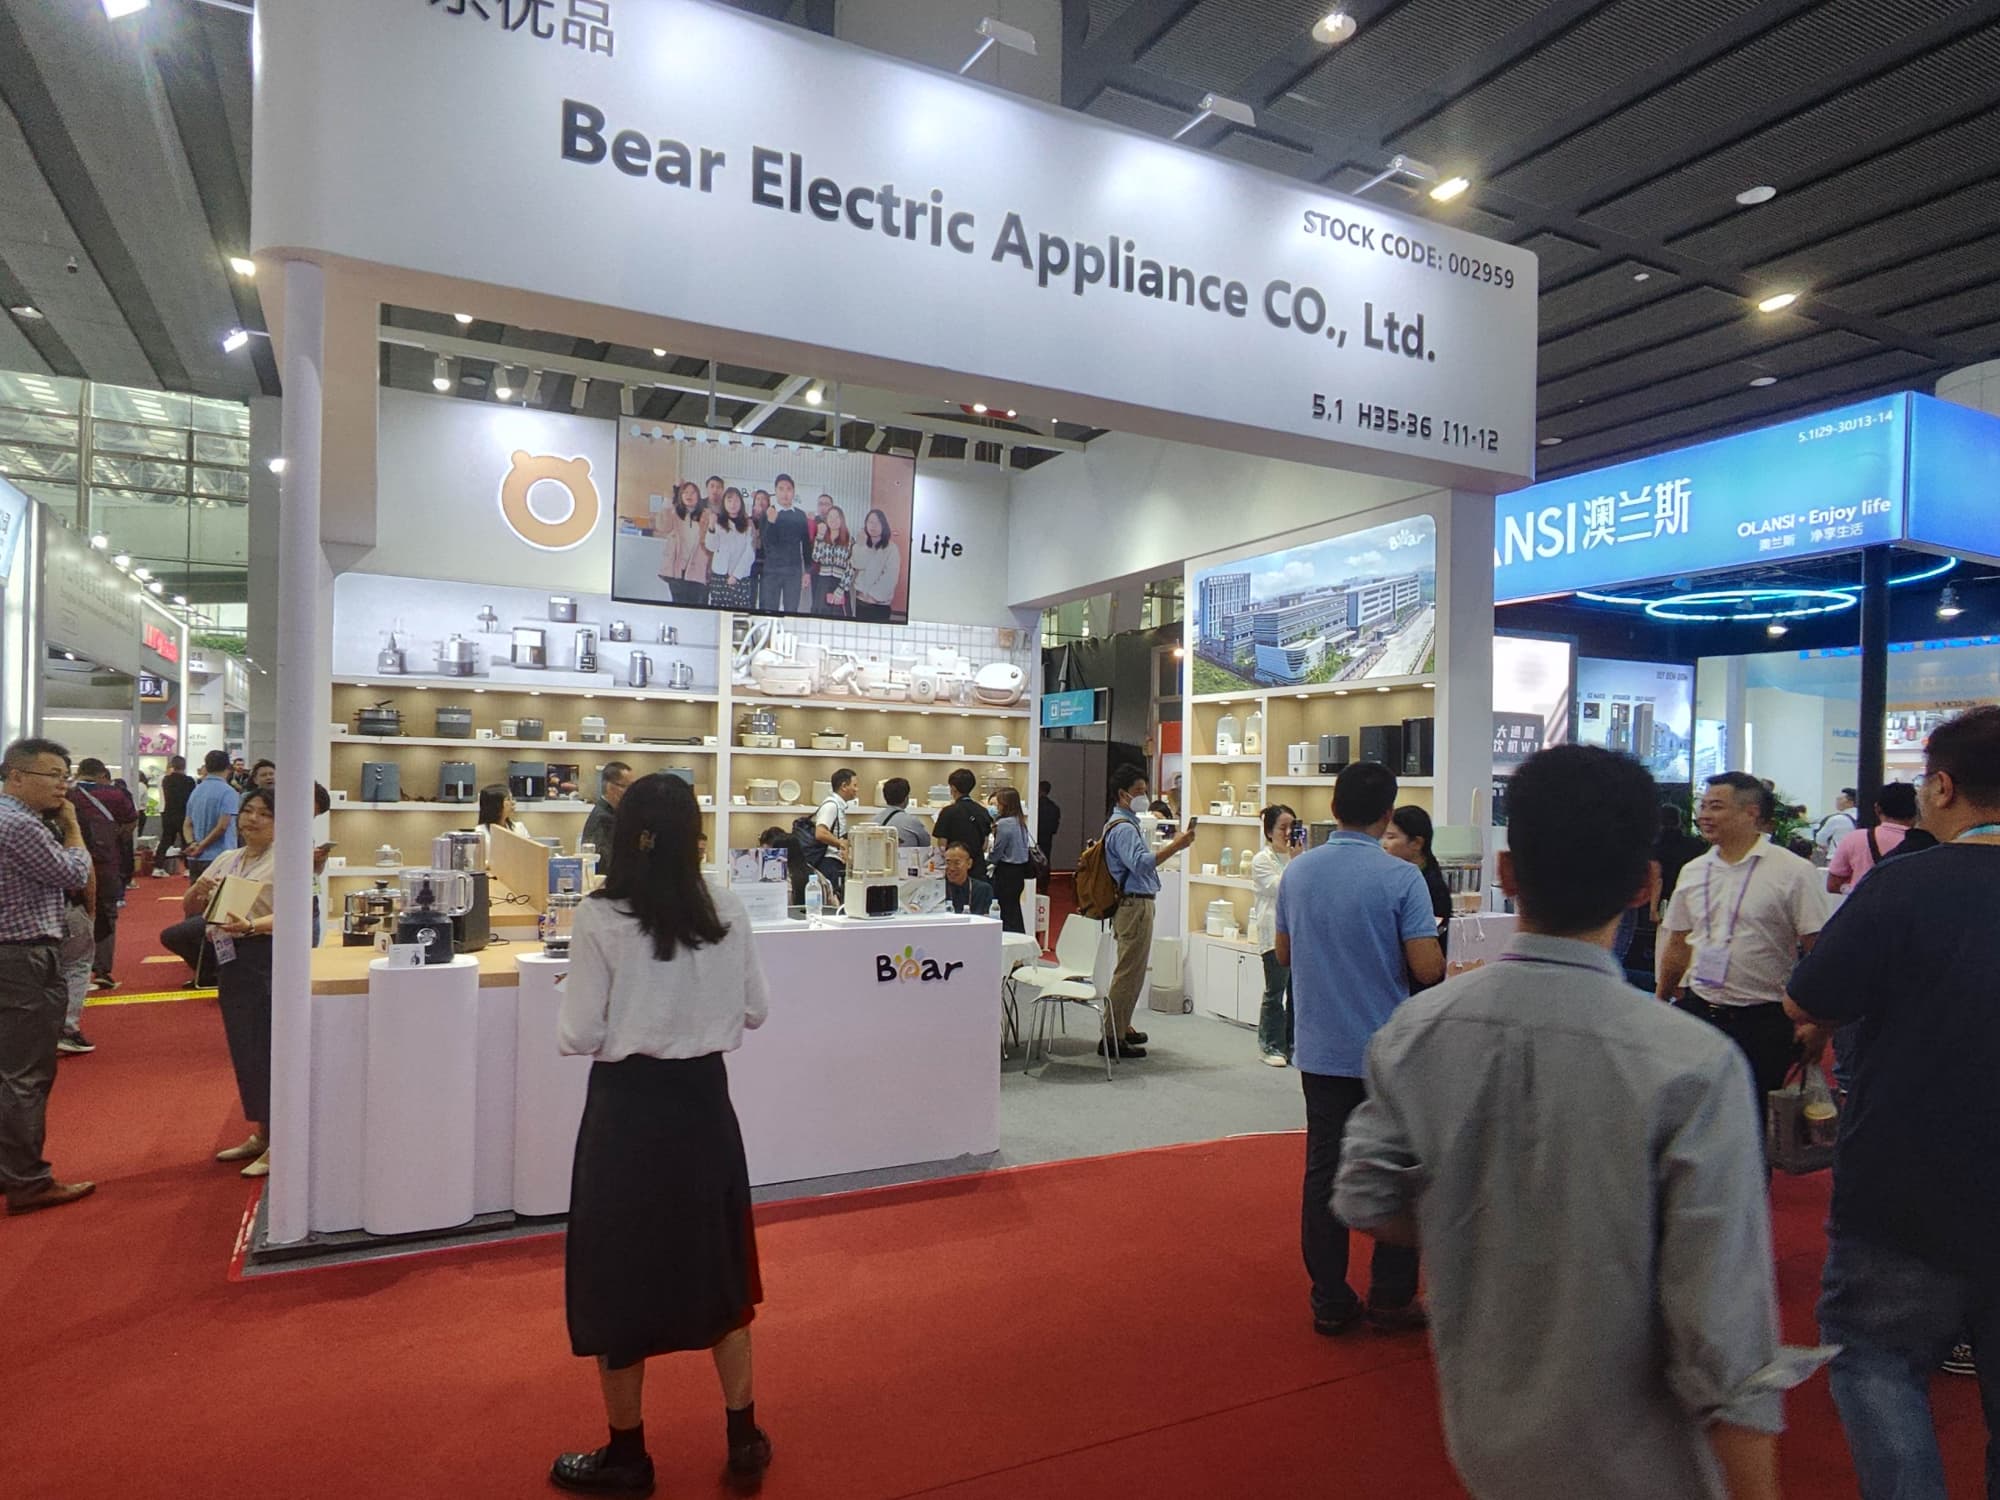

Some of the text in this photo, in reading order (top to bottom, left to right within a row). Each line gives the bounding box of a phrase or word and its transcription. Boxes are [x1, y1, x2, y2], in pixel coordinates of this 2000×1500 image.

[561, 98, 1436, 363] Bear Electric Appliance CO., Ltd.
[1303, 210, 1514, 289] STOCK CODE: 002959
[1312, 393, 1343, 422] 5.1
[1494, 477, 1693, 568] NSI 澳兰斯
[1737, 498, 1892, 537] OLANSI Enjoy life
[920, 533, 963, 560] Life
[876, 945, 964, 984] Bear
